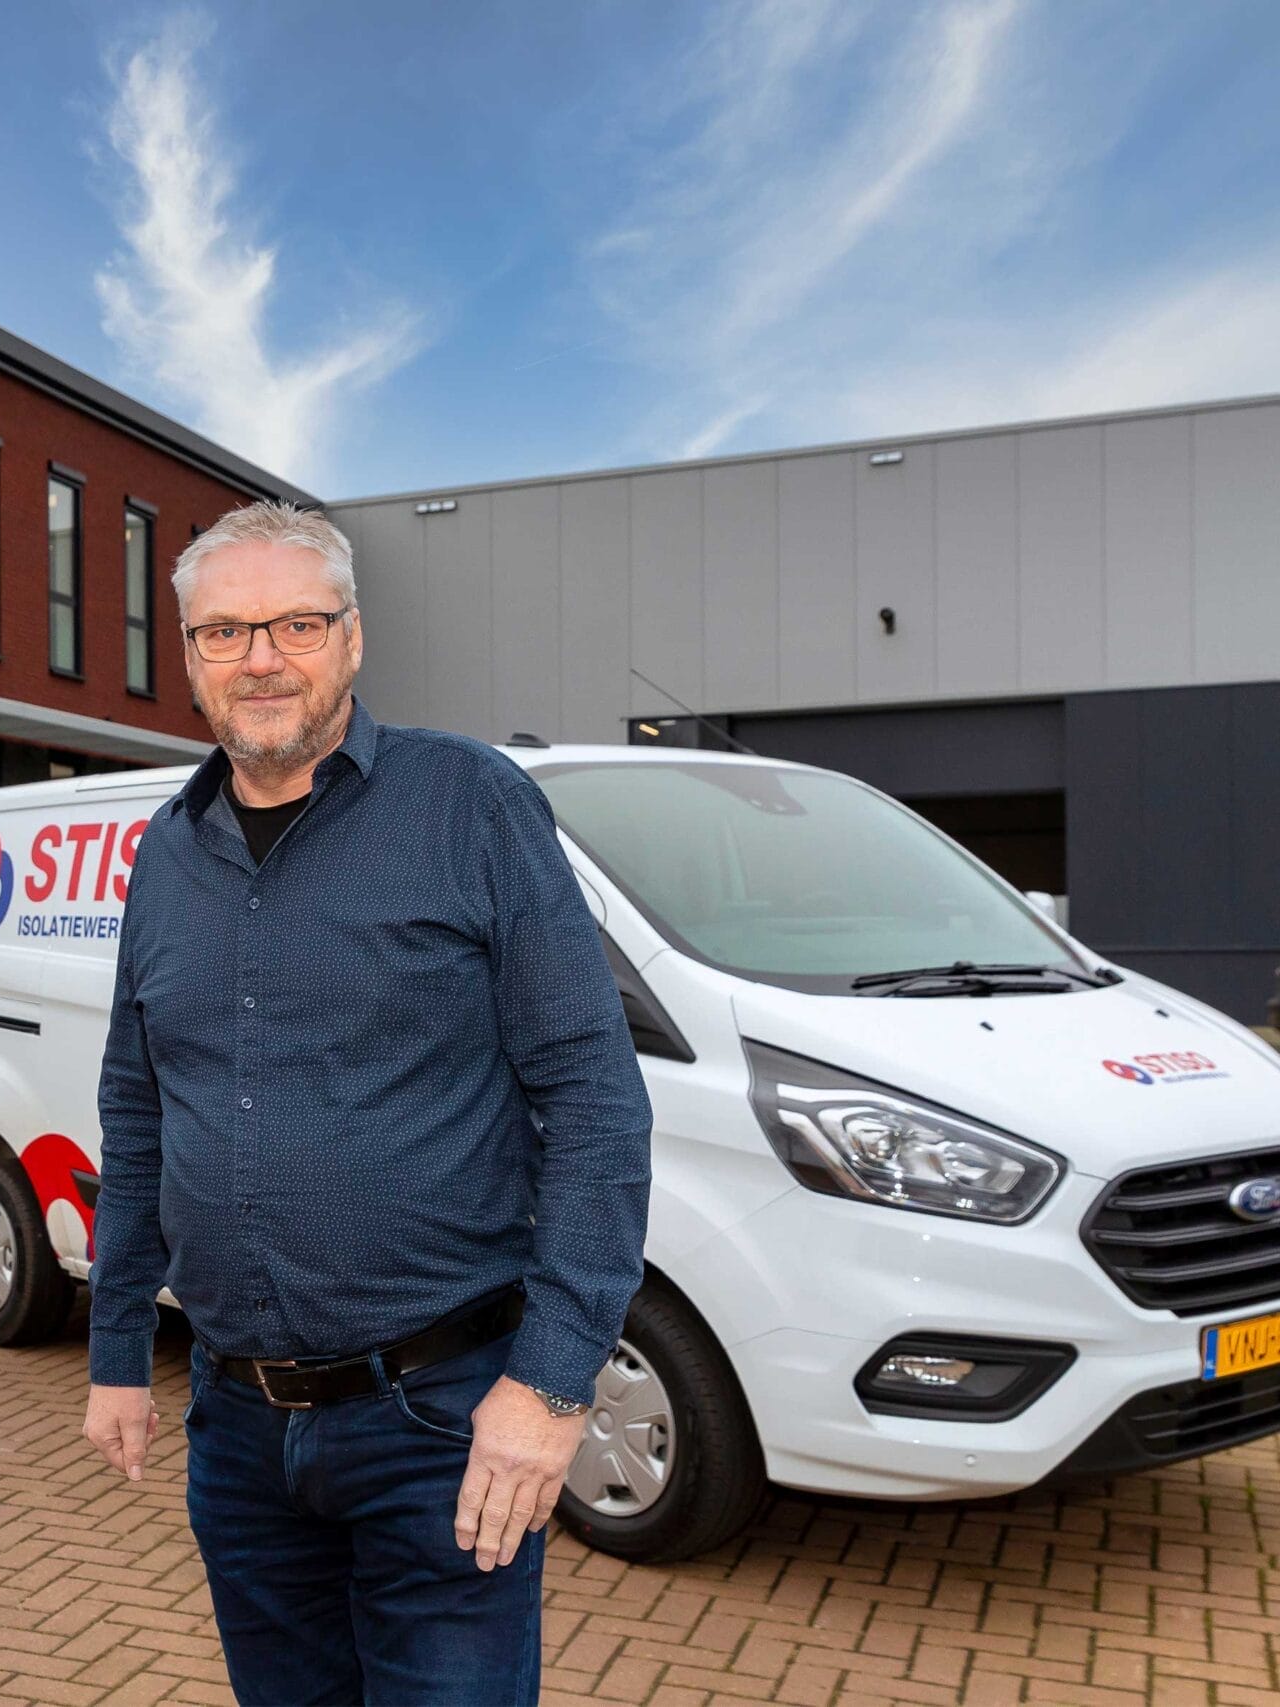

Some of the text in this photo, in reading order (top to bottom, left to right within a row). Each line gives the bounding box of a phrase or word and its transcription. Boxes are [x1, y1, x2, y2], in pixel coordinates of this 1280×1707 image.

[25, 819, 150, 903] STIS
[18, 915, 122, 938] ISOLATIEWER
[1133, 1051, 1216, 1074] STISO
[1228, 1326, 1280, 1366] VNJ-
